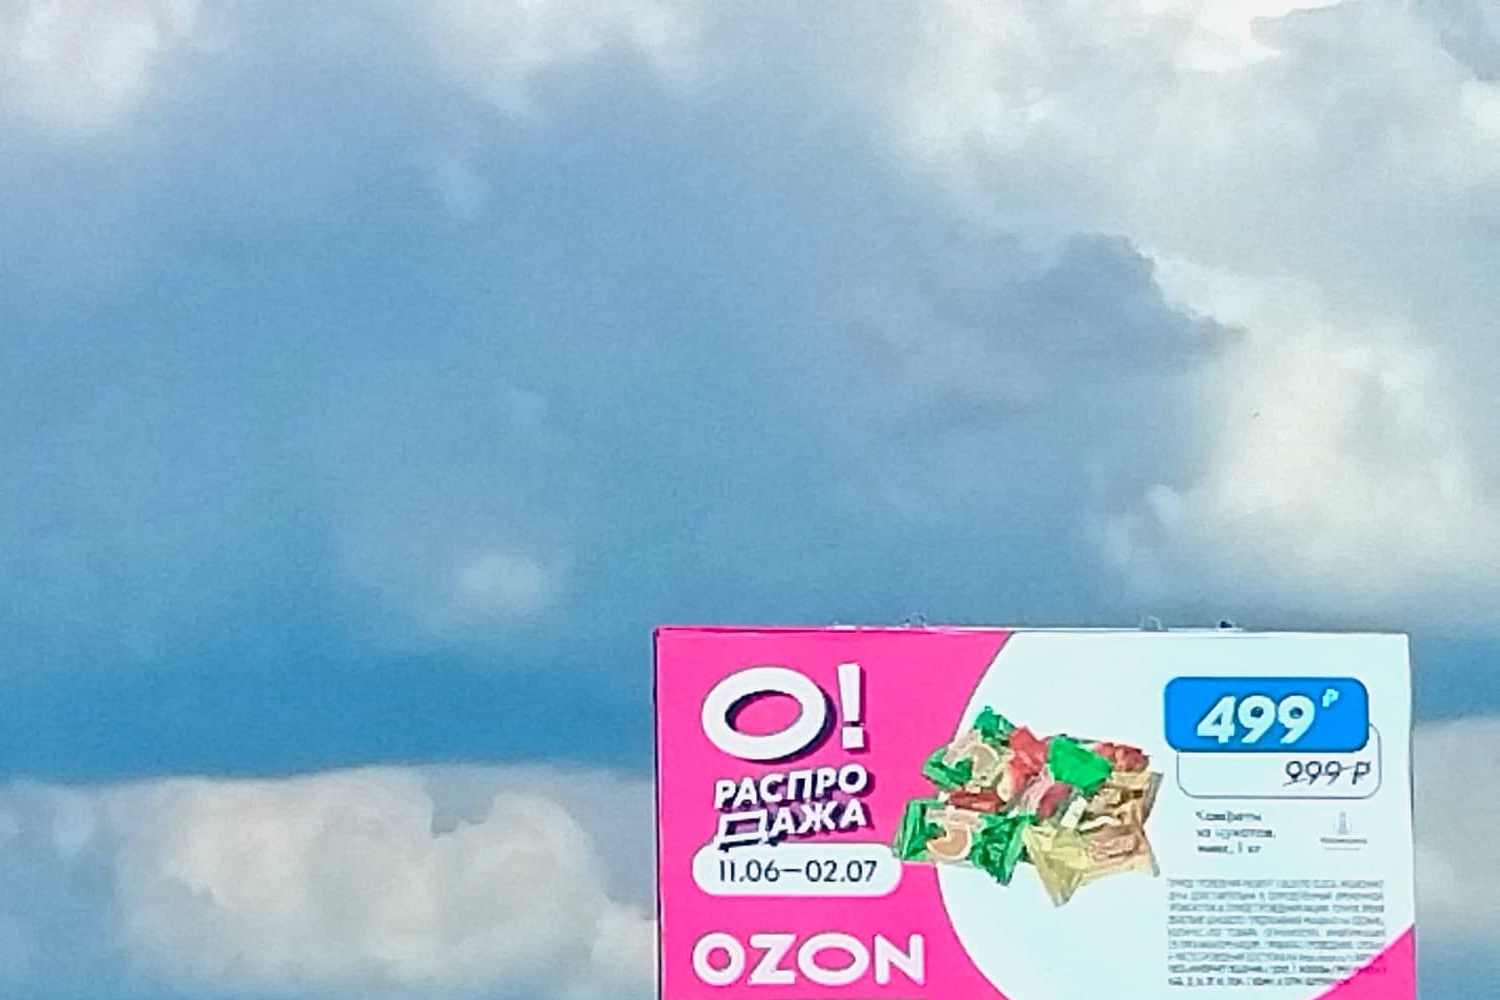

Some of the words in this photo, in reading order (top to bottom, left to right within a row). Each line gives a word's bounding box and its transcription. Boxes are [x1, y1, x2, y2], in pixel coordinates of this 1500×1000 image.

[1197, 695, 1315, 744] 499
[714, 764, 868, 809] РАСПРО
[1284, 760, 1342, 786] 999
[713, 798, 868, 852] ДАЖА
[693, 932, 925, 986] OZON
